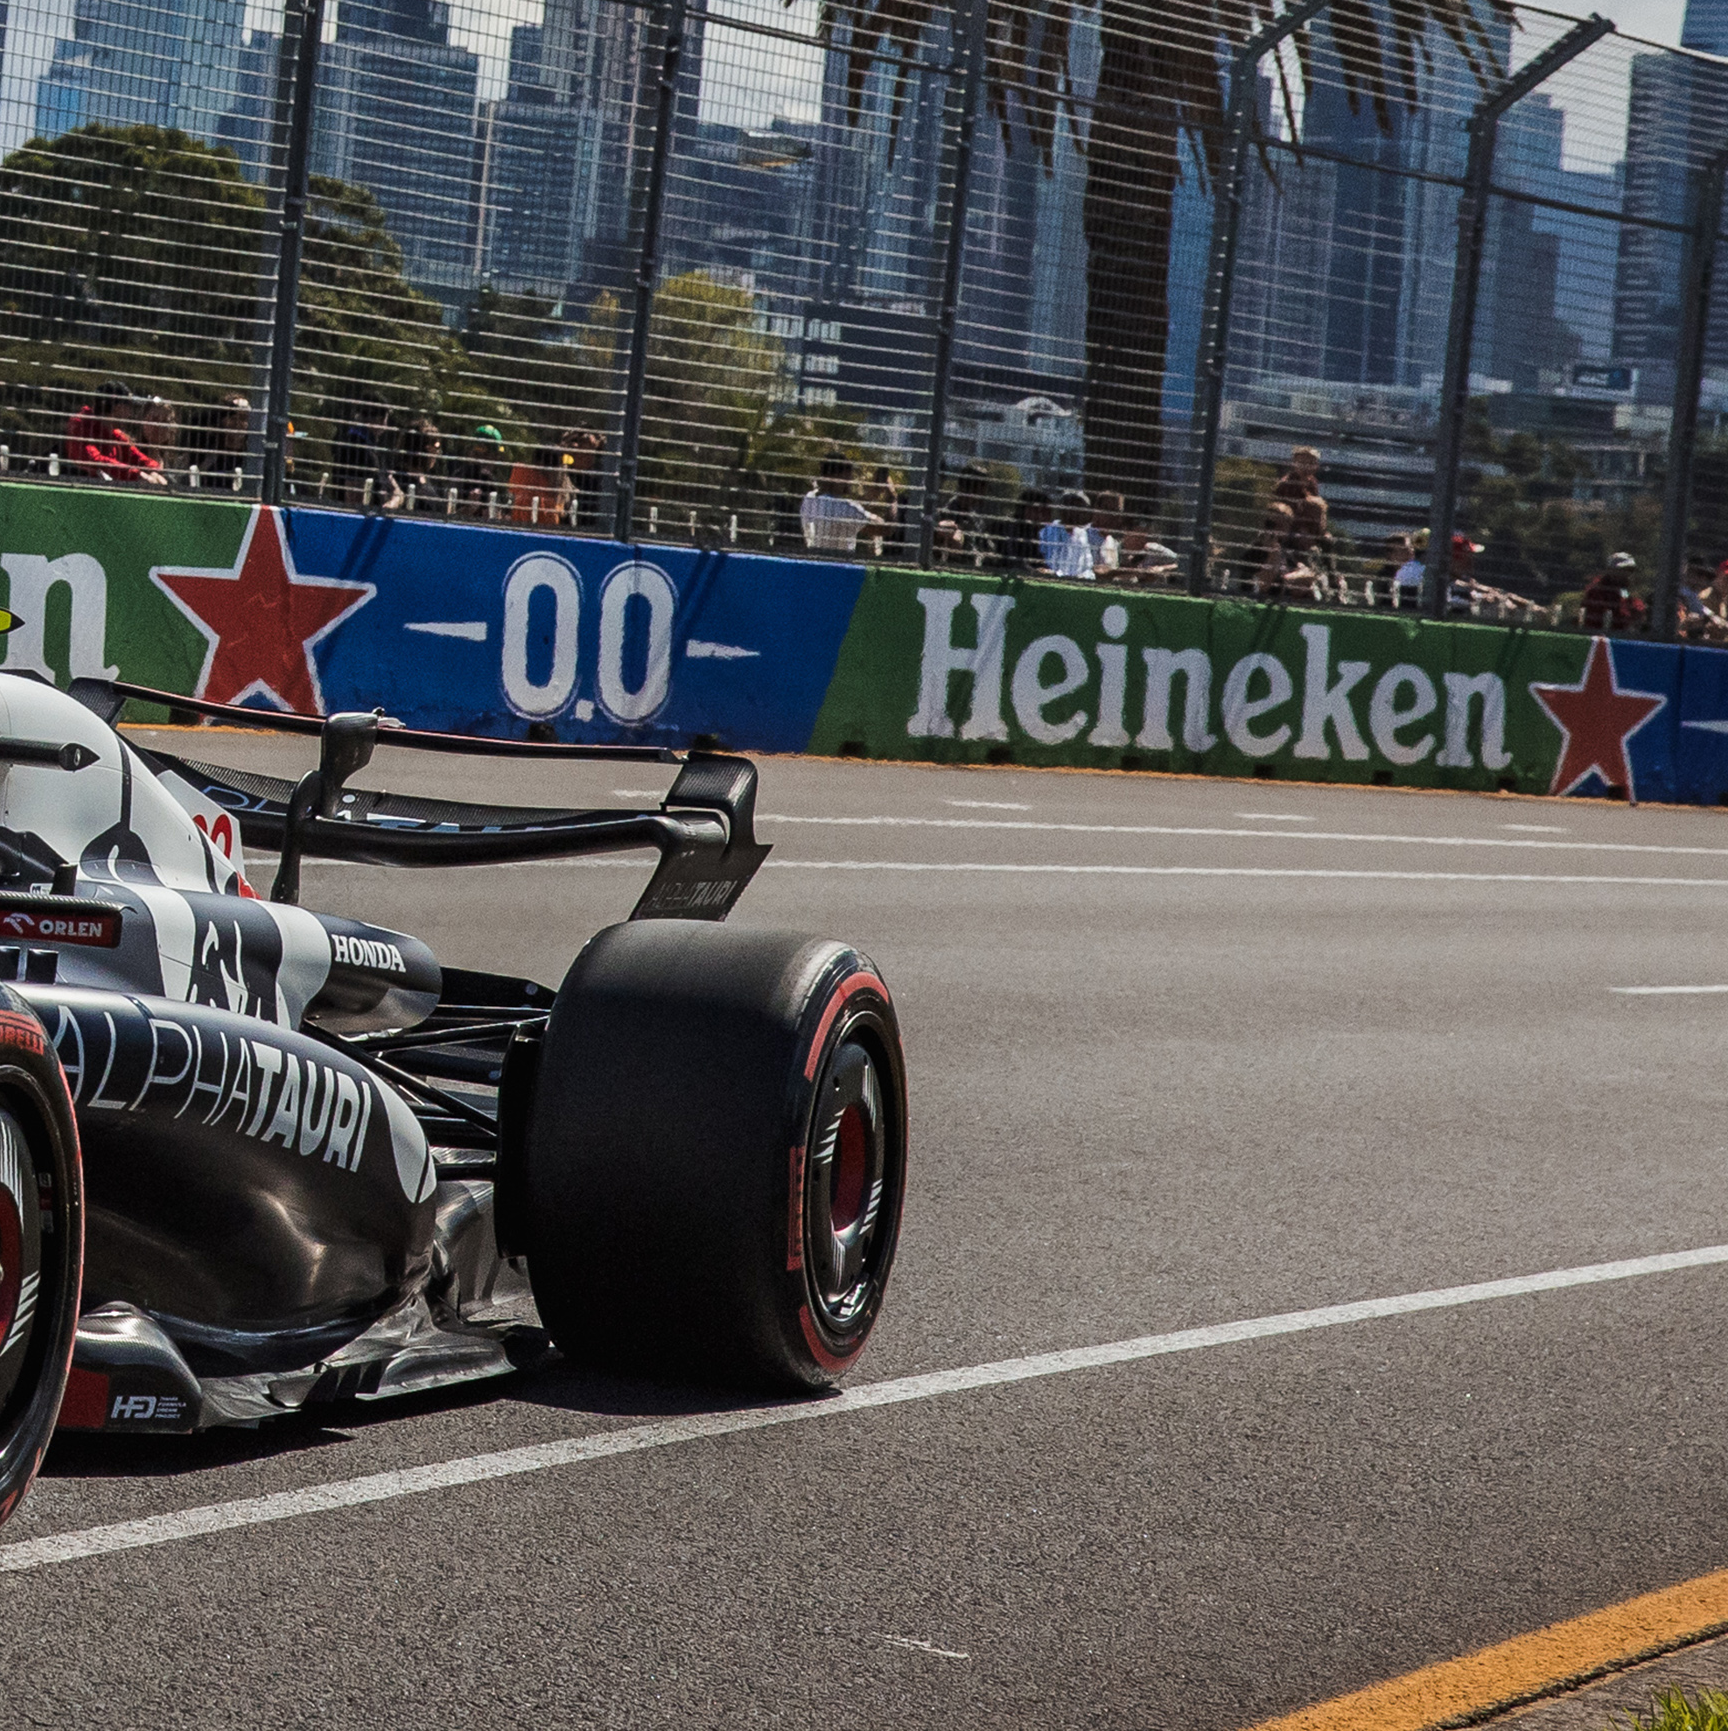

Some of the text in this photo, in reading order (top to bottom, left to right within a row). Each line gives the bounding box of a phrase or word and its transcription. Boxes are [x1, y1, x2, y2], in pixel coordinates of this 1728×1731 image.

[501, 551, 679, 727] 0.0
[905, 586, 1512, 770] Heineken
[39, 919, 103, 938] ORLEN
[333, 934, 407, 973] HONDA
[49, 1005, 373, 1173] ALPHATAURI
